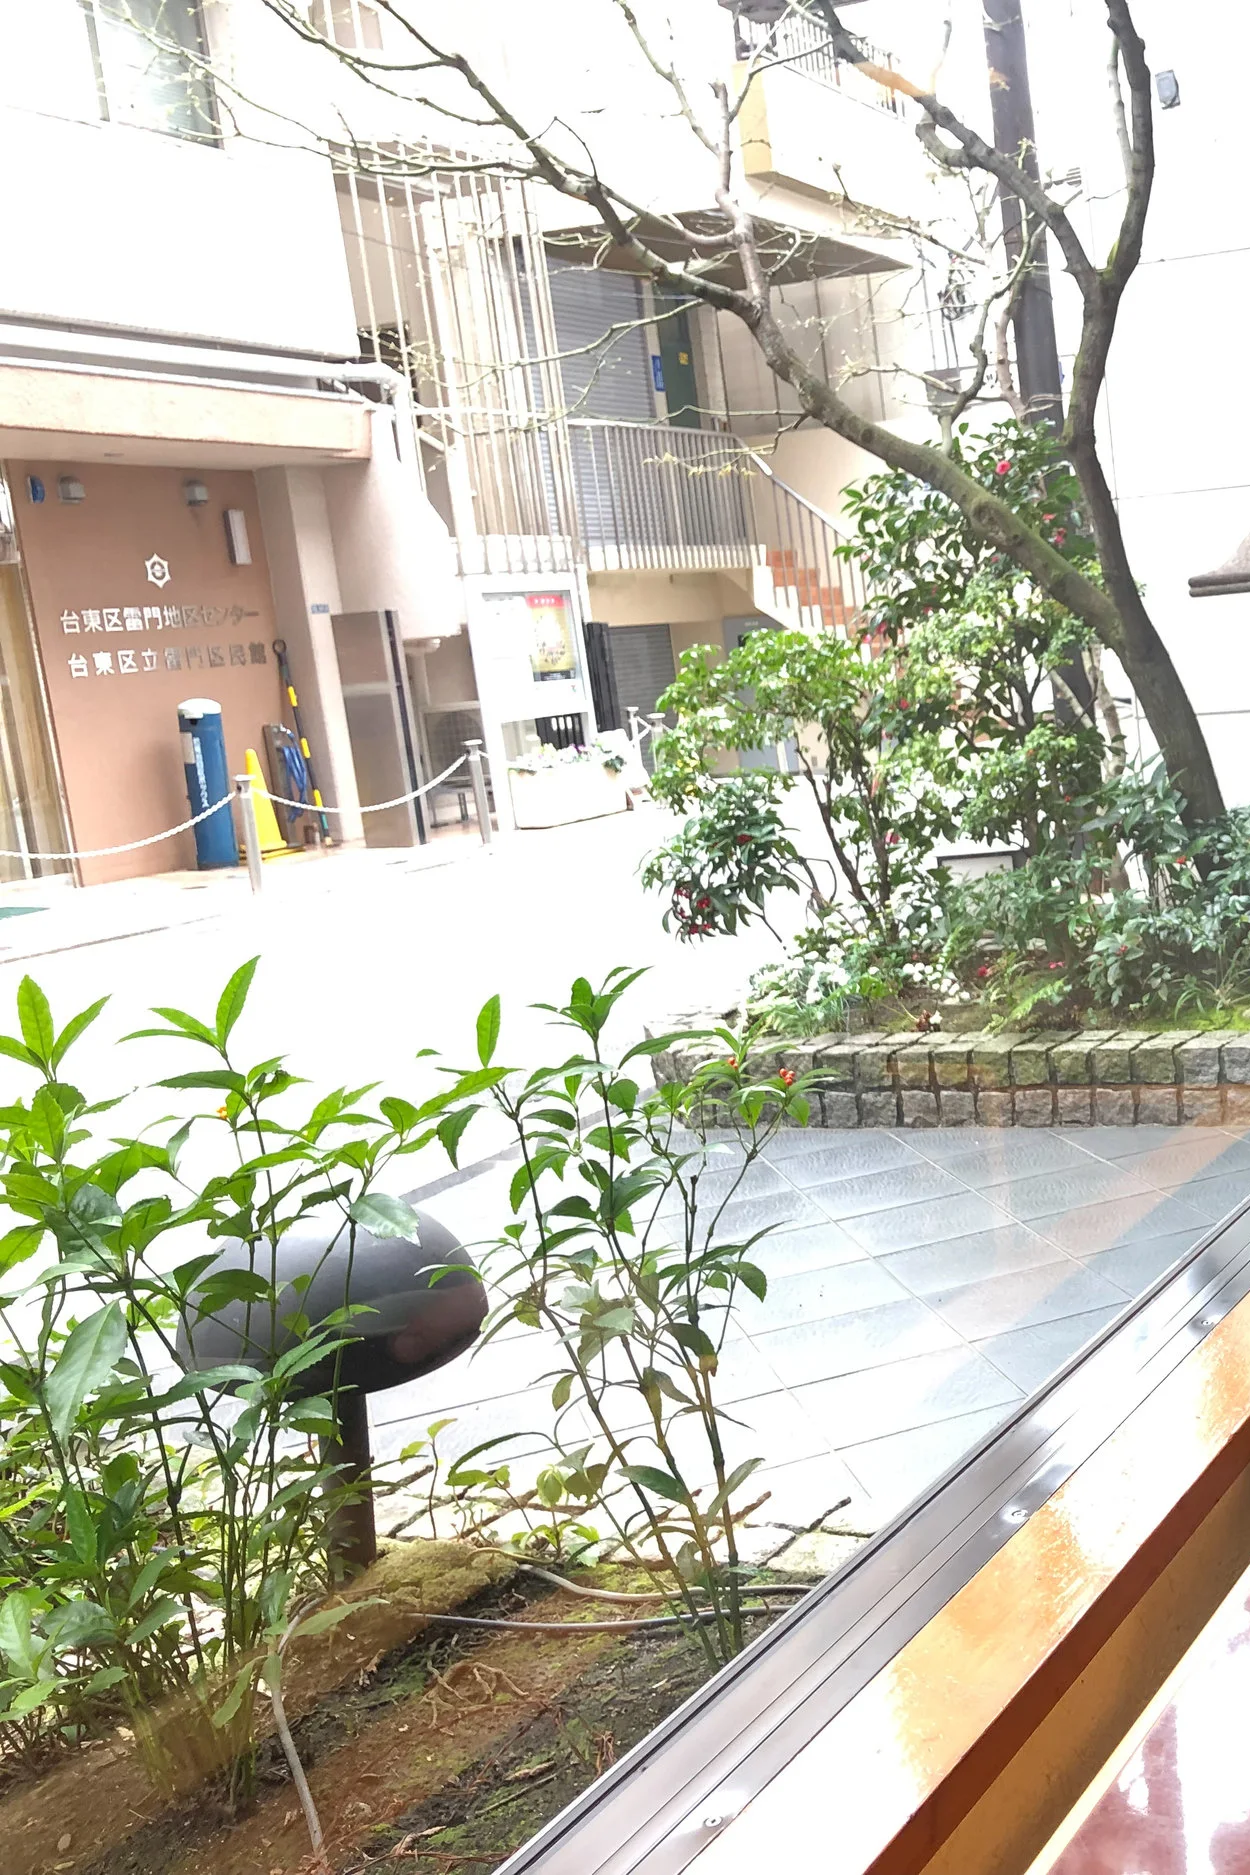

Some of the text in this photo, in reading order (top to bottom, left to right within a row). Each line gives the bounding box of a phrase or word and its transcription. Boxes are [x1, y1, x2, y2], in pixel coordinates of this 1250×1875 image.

[60, 605, 260, 634] 台東区雷門地区センター
